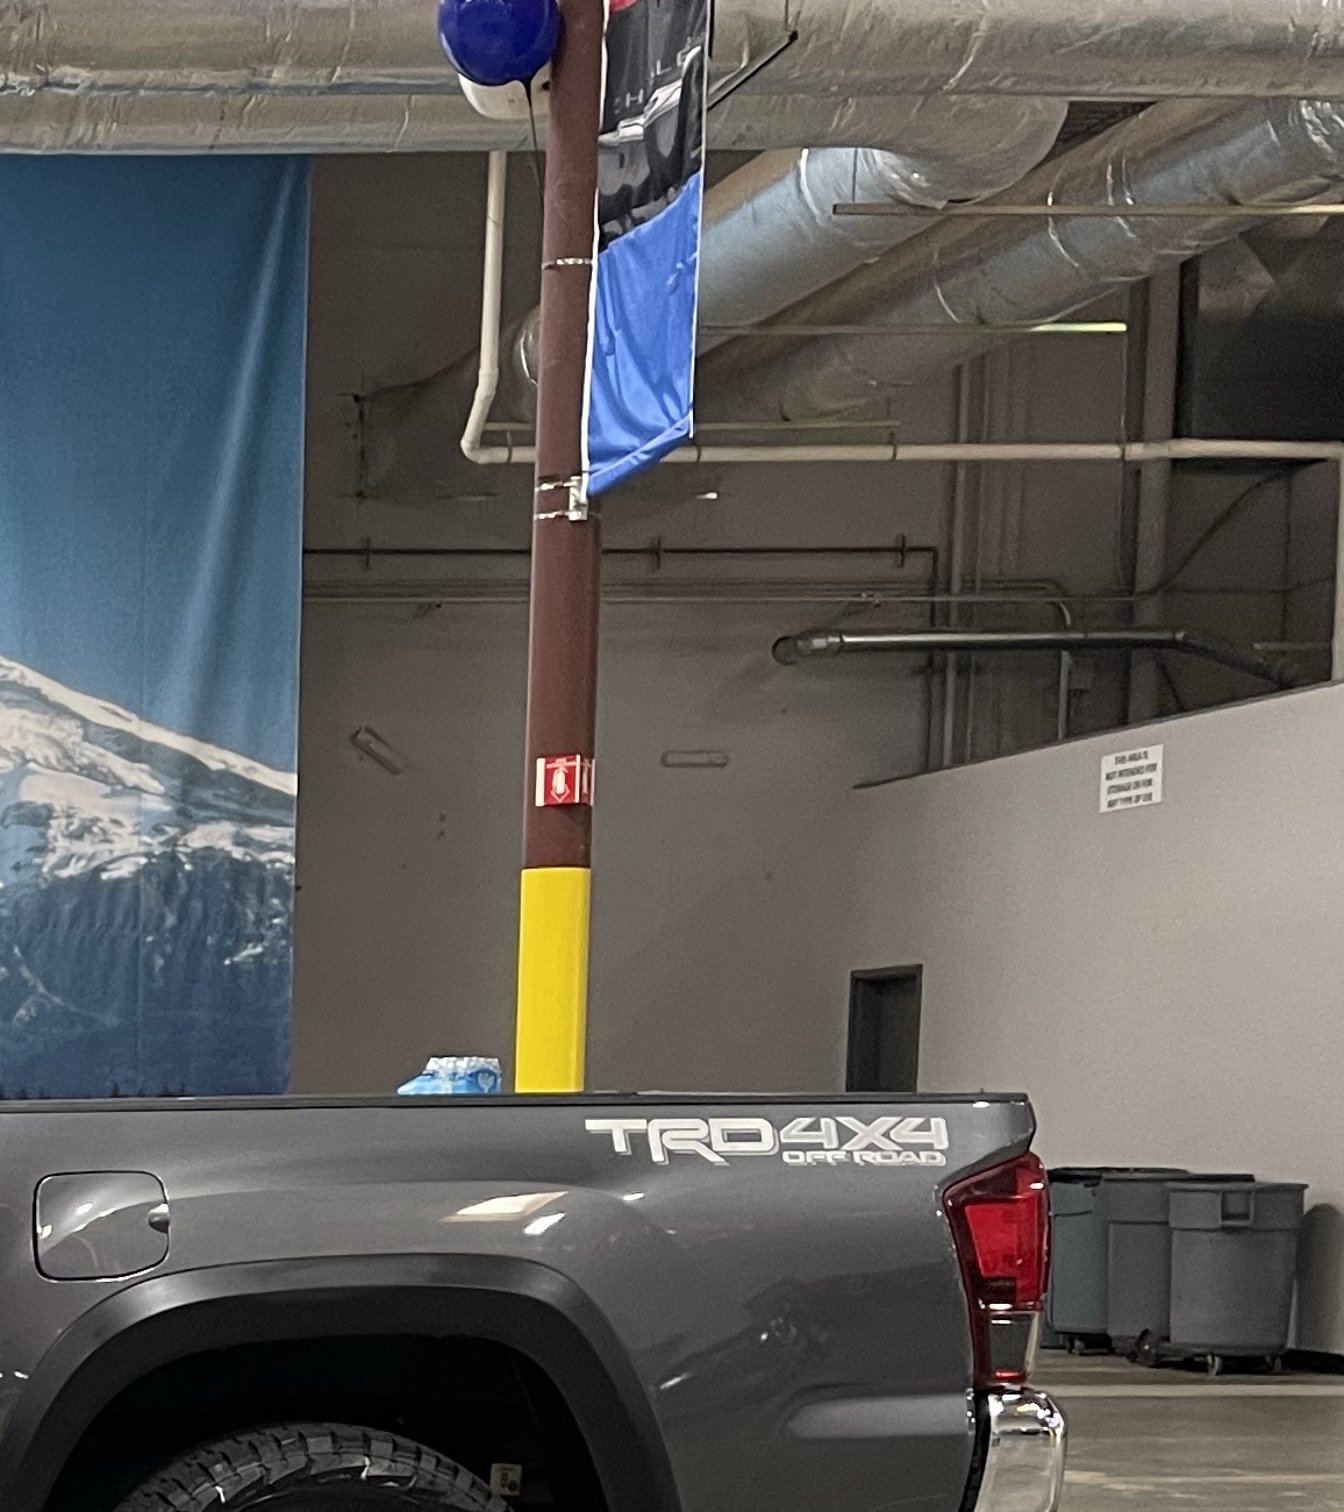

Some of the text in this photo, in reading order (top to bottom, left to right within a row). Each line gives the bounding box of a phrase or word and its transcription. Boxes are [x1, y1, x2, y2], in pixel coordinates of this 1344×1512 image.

[585, 1117, 950, 1166] TRD 4X4
[782, 1150, 947, 1166] OFF ROAD
